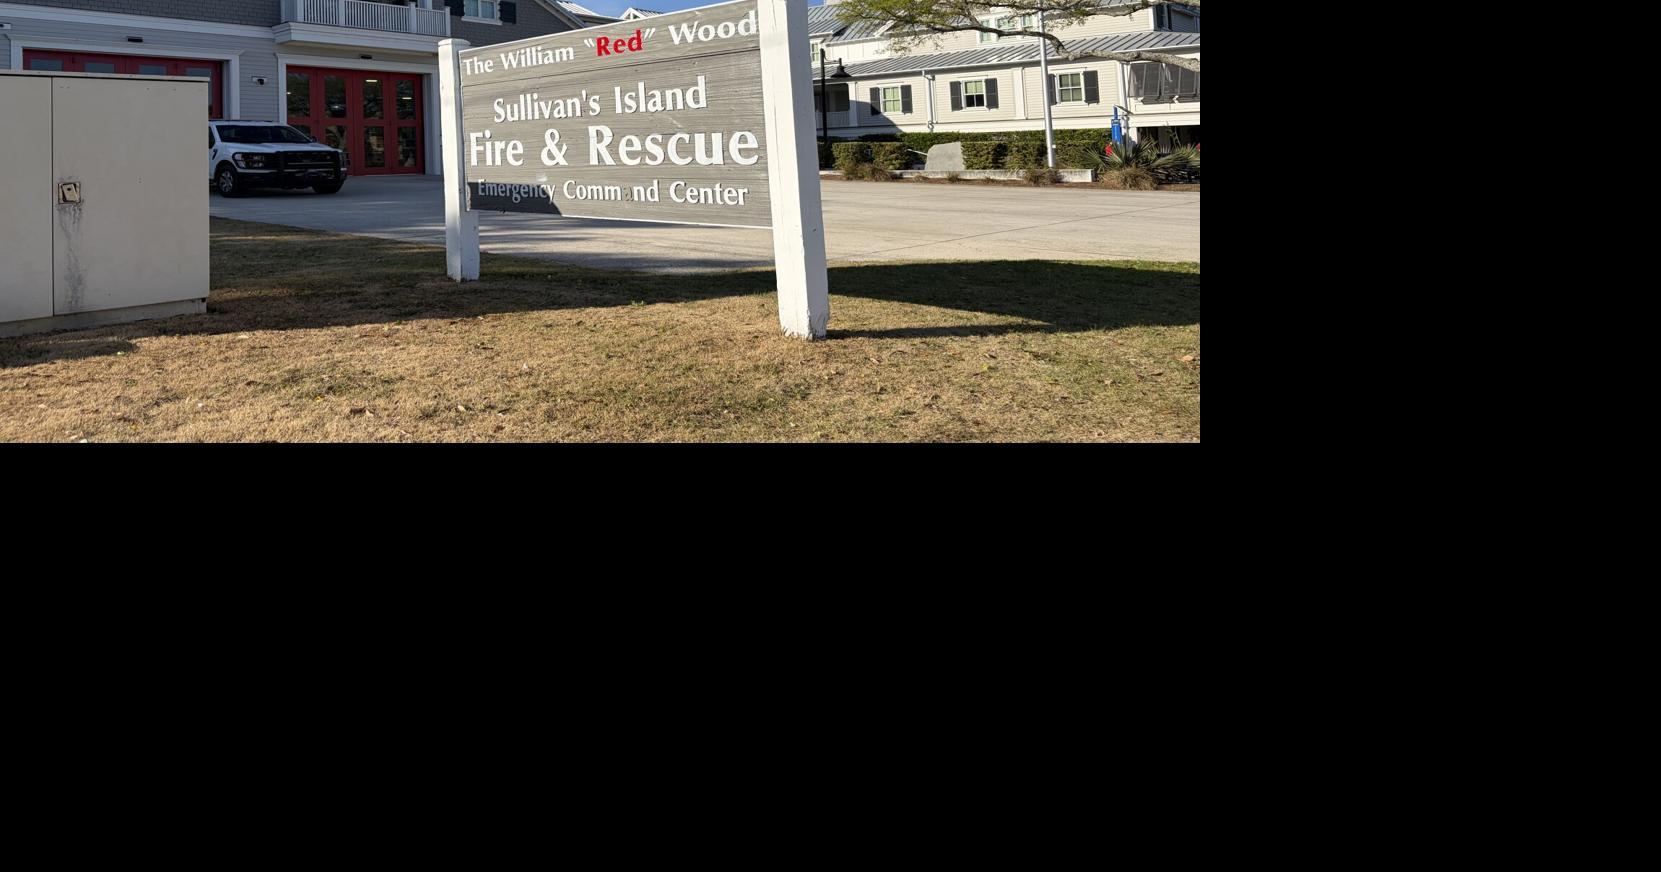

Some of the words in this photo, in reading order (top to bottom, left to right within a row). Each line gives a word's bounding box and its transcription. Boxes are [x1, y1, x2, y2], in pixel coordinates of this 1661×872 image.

[462, 56, 494, 76] The
[500, 46, 575, 70] William
[668, 10, 757, 45] Wood
[493, 90, 601, 123] Sullivan's
[614, 75, 708, 115] Island
[469, 129, 524, 167] Fire
[540, 128, 569, 167] &
[588, 125, 760, 167] Rescue
[477, 179, 556, 204] Emergency
[669, 180, 749, 206] Center
